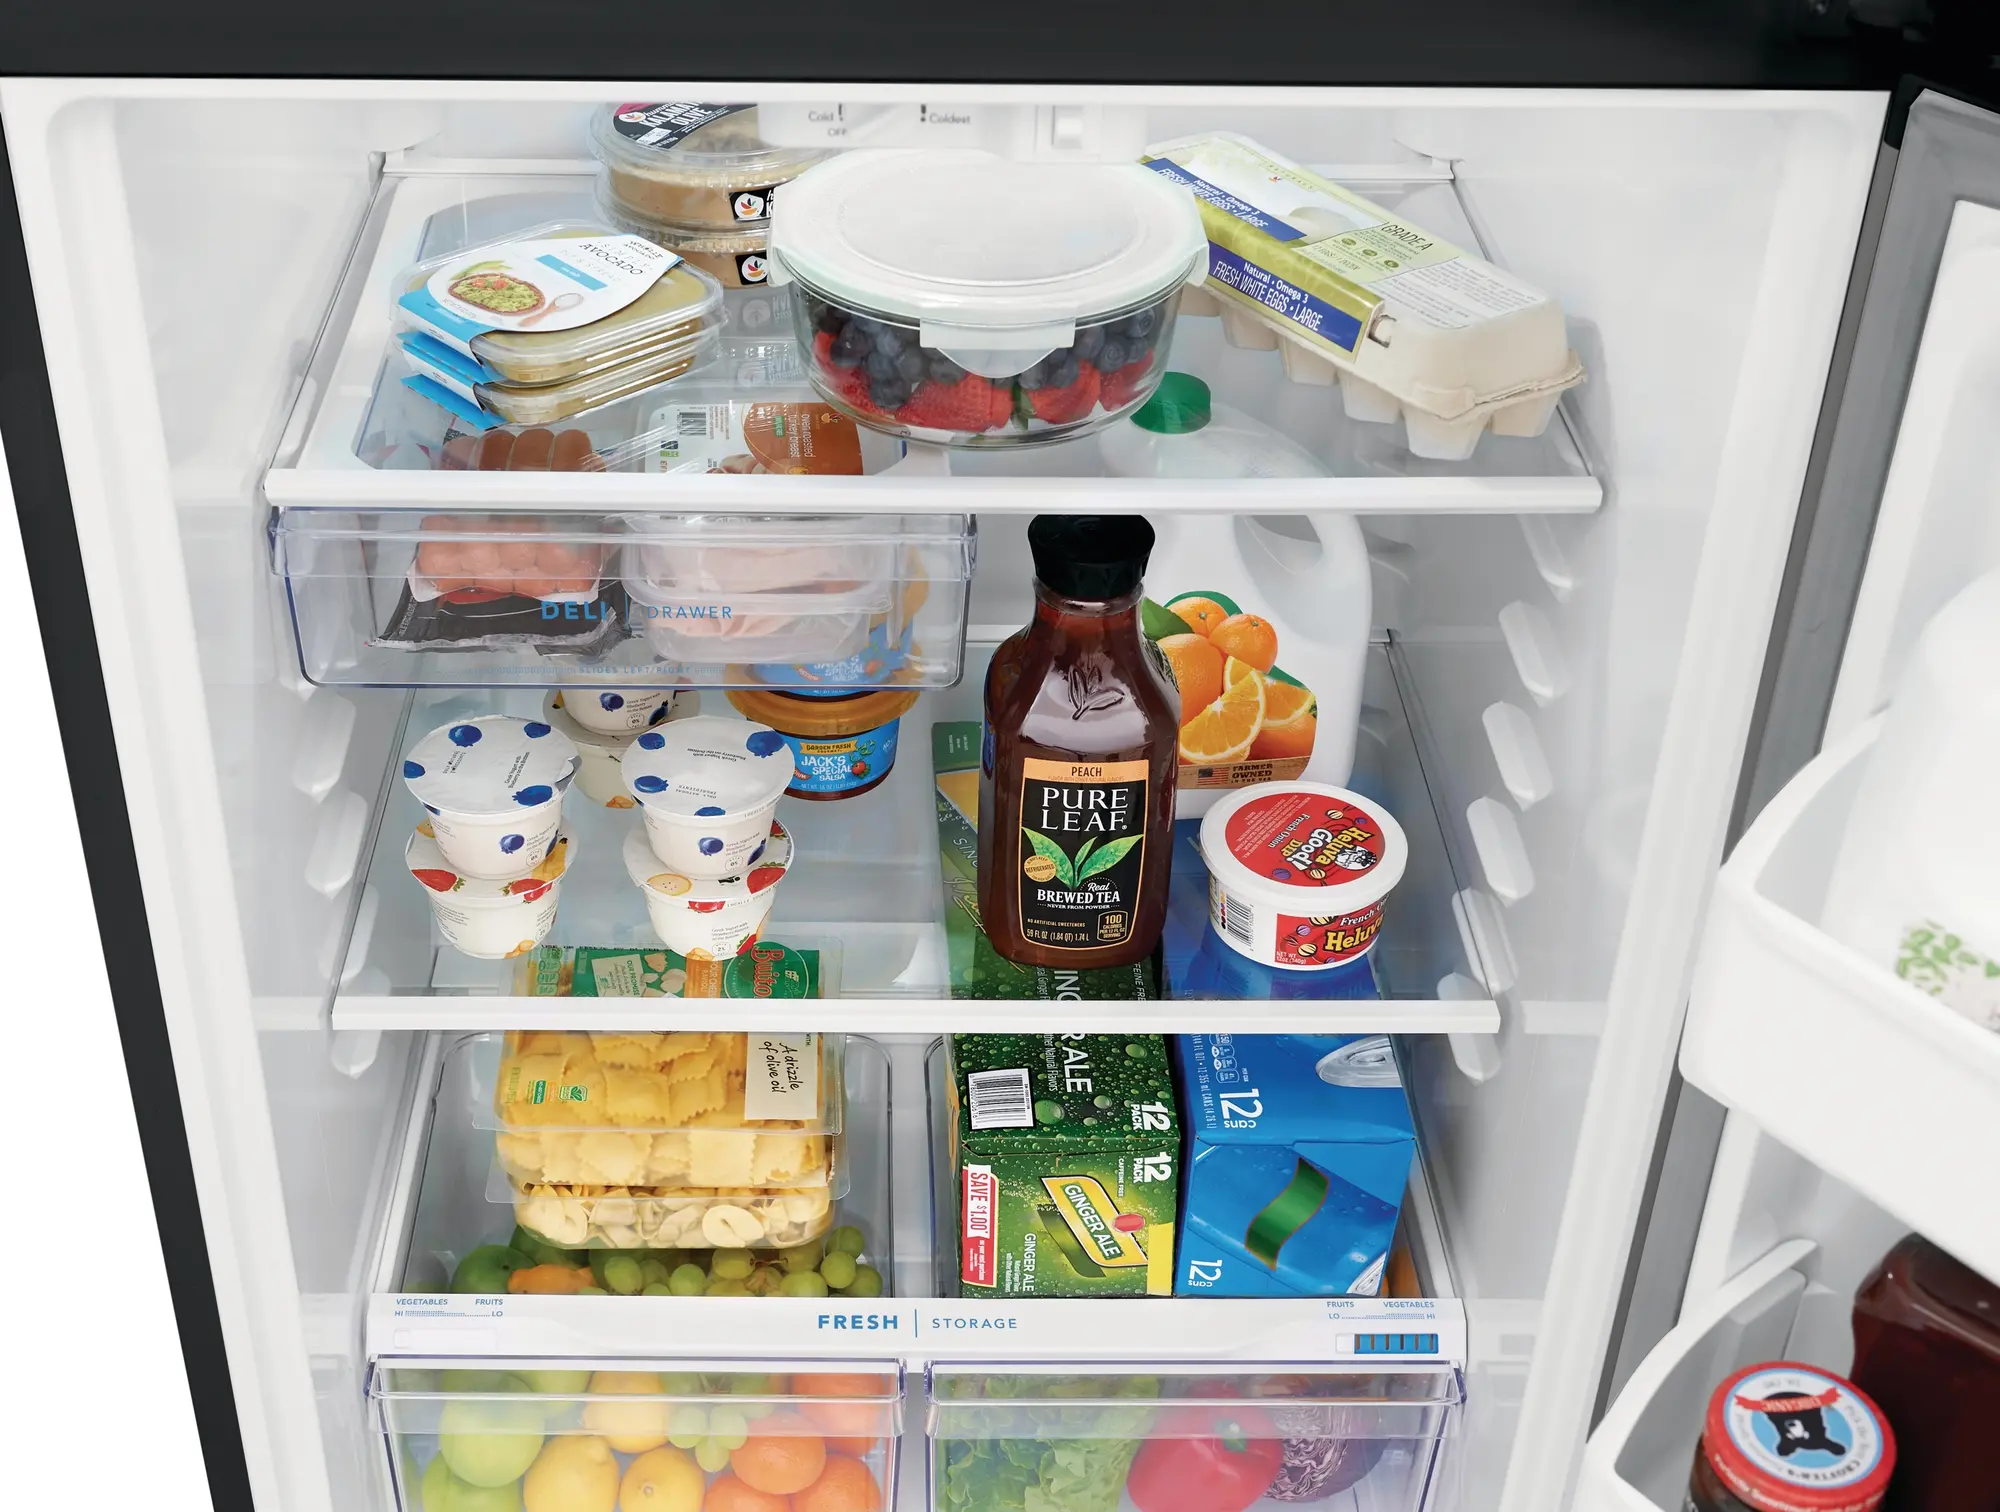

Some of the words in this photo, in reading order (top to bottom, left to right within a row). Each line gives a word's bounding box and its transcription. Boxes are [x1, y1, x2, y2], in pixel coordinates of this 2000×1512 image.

[670, 107, 713, 126] OLIVE
[808, 111, 834, 122] Cold
[929, 112, 971, 124] Coldest
[828, 128, 847, 137] OFF
[1381, 224, 1426, 246] GRADE
[579, 242, 644, 275] AVOCADO
[1243, 262, 1271, 285] Natural
[1276, 280, 1302, 301] Omega
[1302, 293, 1309, 304] 3
[1213, 260, 1242, 287] FRESH
[1239, 273, 1267, 302] WHITE
[1264, 288, 1289, 314] EGGS
[1292, 304, 1323, 331] LARGE
[541, 600, 607, 621] DELI
[647, 605, 732, 619] DRAWER
[579, 665, 619, 675] SLIDES
[623, 665, 691, 675] LEFT/RIGHT
[801, 755, 846, 767] JACK'S
[812, 764, 852, 776] SPECIAL
[1232, 763, 1273, 772] FARMER
[819, 773, 846, 781] SALSA
[1071, 766, 1102, 777] PEACH
[1232, 770, 1272, 779] OWNED
[1041, 787, 1129, 810] PURE
[1041, 808, 1125, 832] LEAF
[1286, 813, 1311, 832] French
[1268, 831, 1291, 849] Onion
[1281, 838, 1303, 858] DIP
[1315, 826, 1375, 866] Heluva
[1286, 828, 1335, 872] Good!
[1037, 888, 1093, 904] BREWED
[1095, 890, 1121, 903] TEA
[1087, 882, 1109, 892] Real
[1034, 919, 1057, 927] ARTIFICIAL
[1104, 914, 1122, 924] 100
[1340, 909, 1374, 926] French
[1026, 928, 1034, 937] 59
[1034, 929, 1040, 938] FL
[1041, 930, 1048, 939] OZ
[1050, 931, 1064, 942] (1.84
[1064, 932, 1074, 942] QT)
[1075, 932, 1085, 941] 1.74
[627, 960, 635, 972] OUR
[750, 945, 785, 997] Buito
[1132, 962, 1144, 986] FEINE
[629, 972, 640, 996] PROMISE
[1036, 983, 1049, 996] Ginger
[1136, 987, 1147, 1001] FRE
[759, 1041, 779, 1053] of
[779, 1042, 798, 1054] A
[1044, 1033, 1056, 1047] ther
[766, 1055, 781, 1078] olive
[1046, 1048, 1057, 1069] Natural
[784, 1055, 804, 1091] drizzle
[1061, 1046, 1093, 1093] ALE
[771, 1081, 786, 1093] oil
[1049, 1069, 1059, 1091] Flavors
[1202, 1093, 1214, 1107] CANS
[1219, 1088, 1263, 1119] 12
[1131, 1104, 1143, 1131] PACK
[1142, 1101, 1171, 1130] 12
[1223, 1120, 1257, 1128] cans
[1133, 1157, 1144, 1183] PACK
[1144, 1151, 1172, 1182] 12
[970, 1172, 989, 1201] SAVE
[1064, 1184, 1104, 1235] GINGER
[1094, 1231, 1120, 1258] ALE
[1024, 1233, 1036, 1273] GINGER
[1189, 1259, 1222, 1279] 12
[1023, 1274, 1035, 1292] ALE
[1187, 1278, 1213, 1287] cans
[396, 1298, 448, 1306] VEGETABLES
[475, 1298, 503, 1306] FRUITS
[818, 1314, 898, 1330] FRESH
[932, 1318, 1017, 1329] STORAGE
